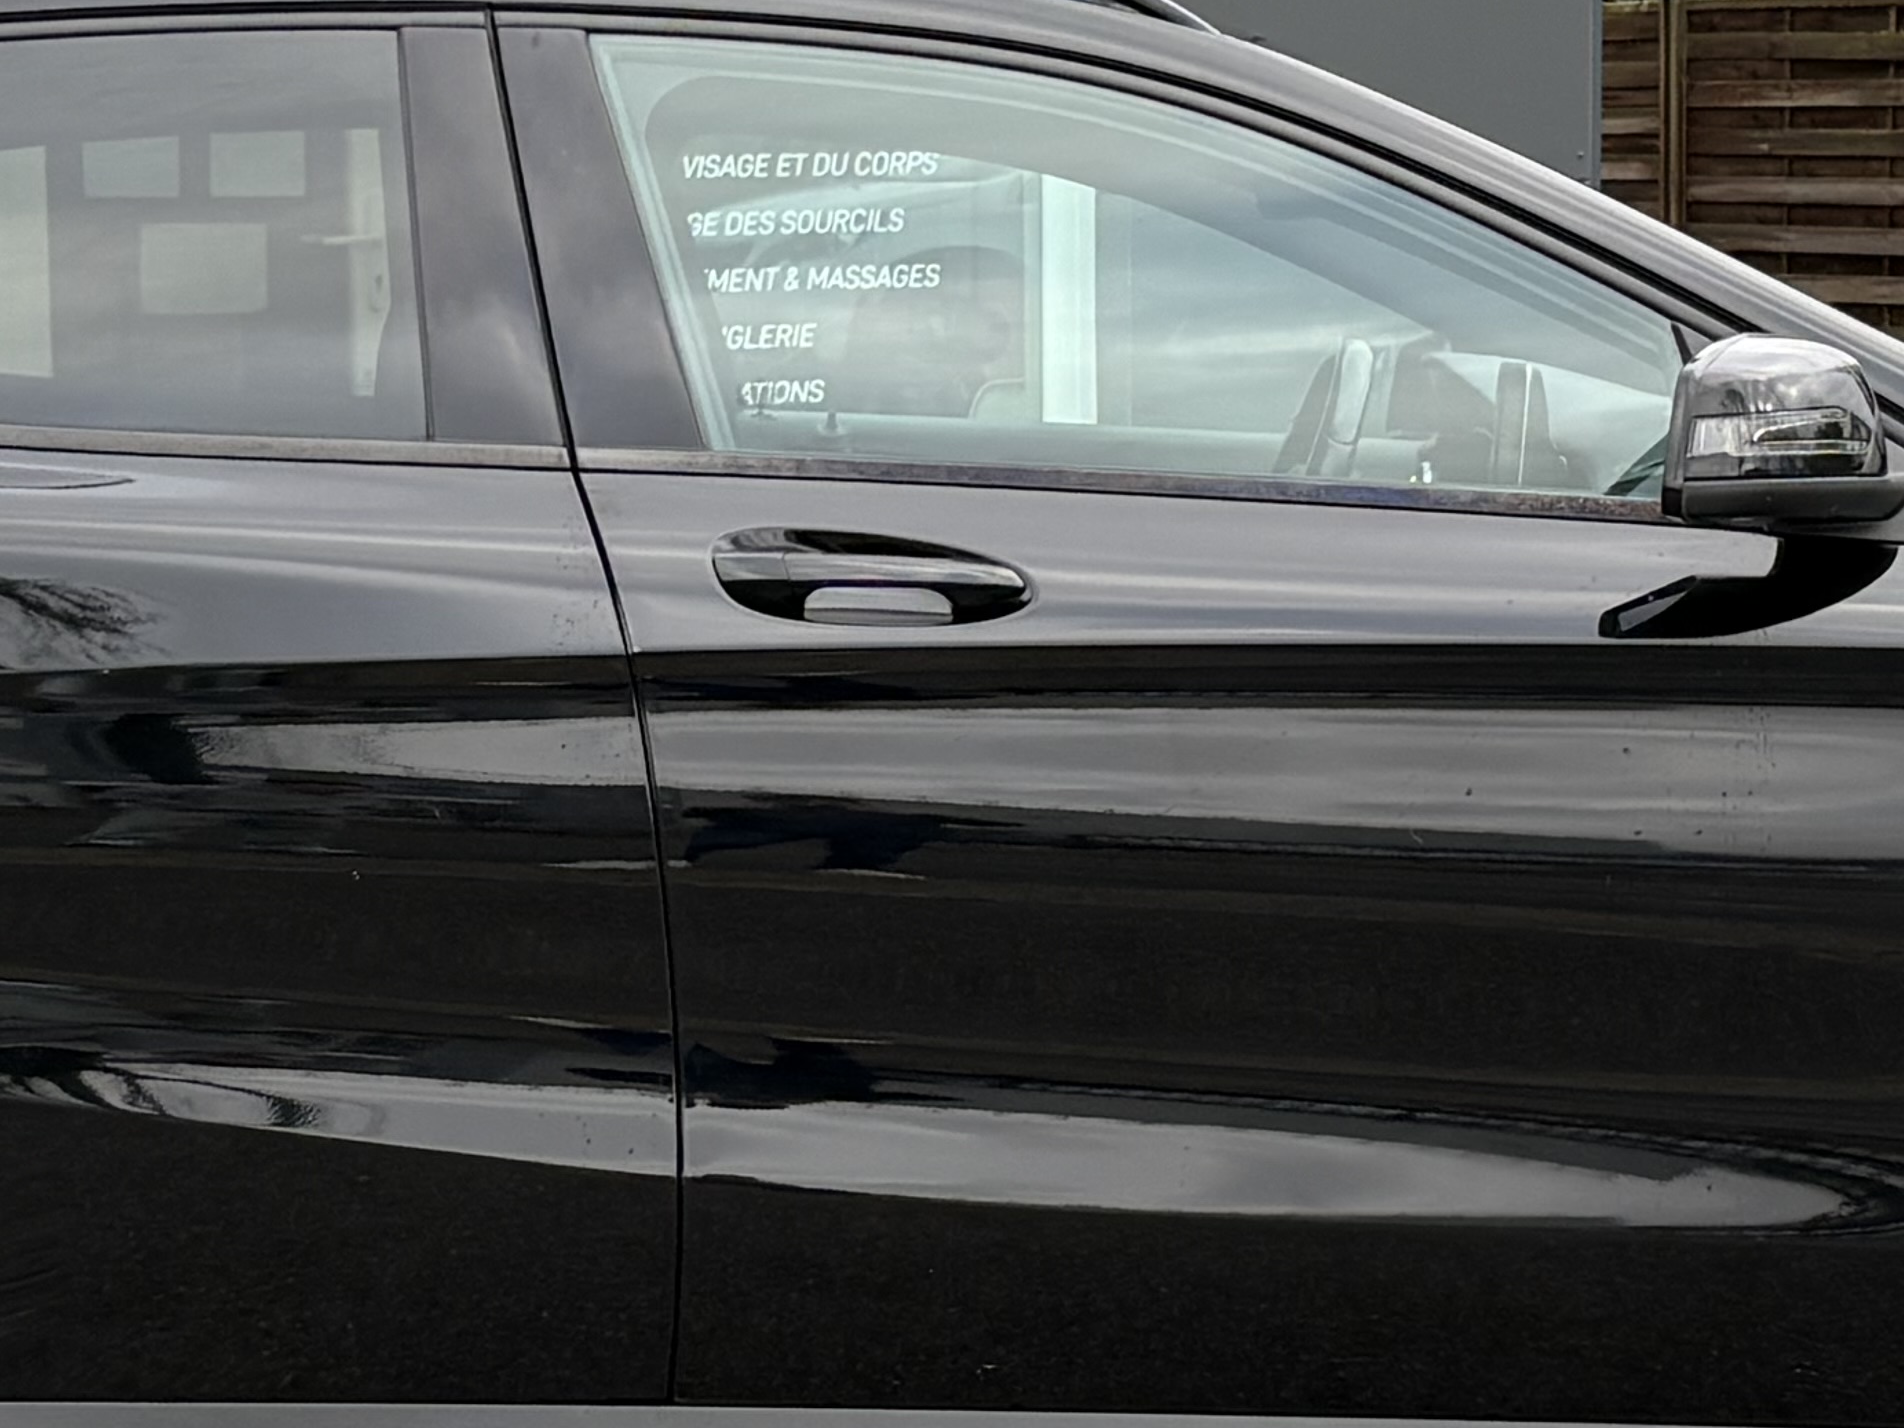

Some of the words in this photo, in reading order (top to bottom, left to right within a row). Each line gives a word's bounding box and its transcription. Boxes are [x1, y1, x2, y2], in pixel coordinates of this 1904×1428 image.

[681, 152, 773, 179] VISAGE
[775, 151, 810, 178] ET
[811, 151, 850, 177] DU
[853, 150, 941, 176] CORPS
[724, 210, 777, 237] DES
[779, 207, 906, 235] SOURCILS
[703, 265, 781, 293] MENT
[783, 264, 800, 292] &
[806, 262, 942, 291] MASSAGES
[721, 321, 818, 351] GLERIE
